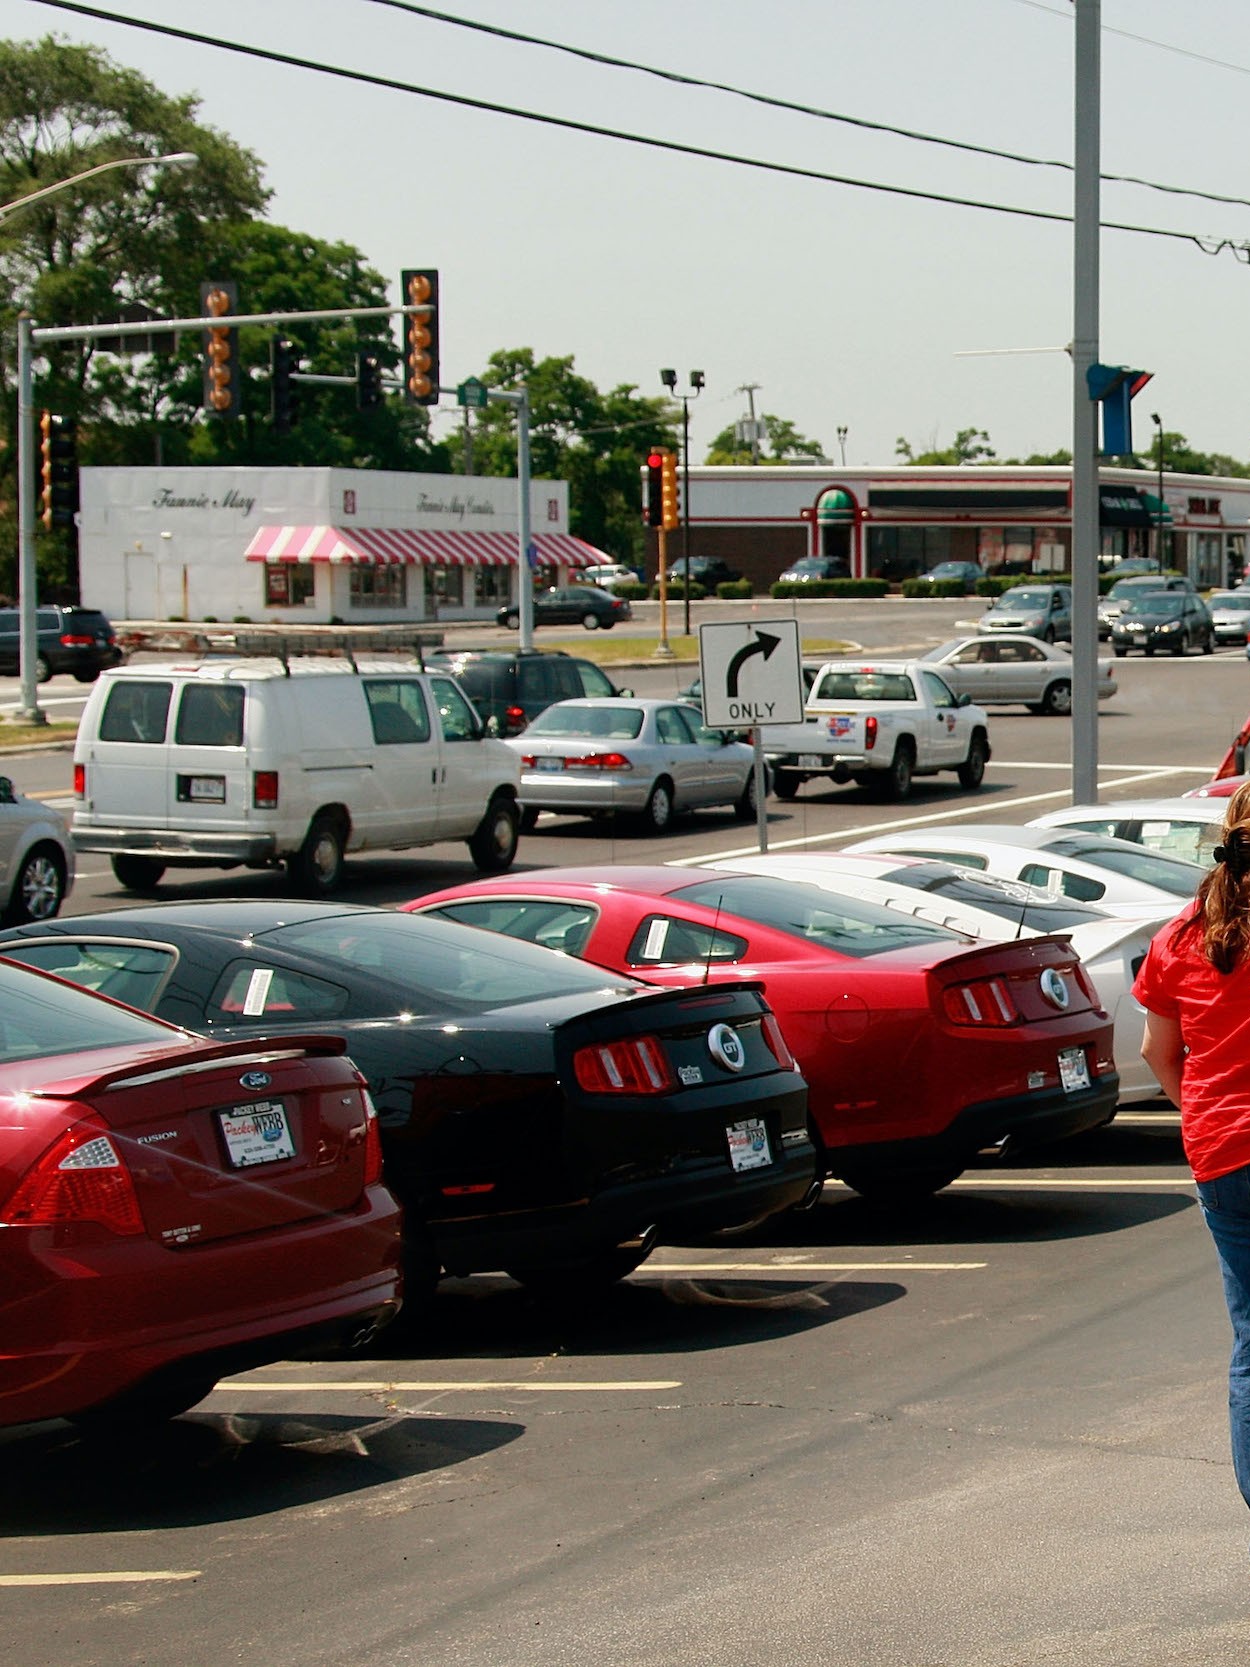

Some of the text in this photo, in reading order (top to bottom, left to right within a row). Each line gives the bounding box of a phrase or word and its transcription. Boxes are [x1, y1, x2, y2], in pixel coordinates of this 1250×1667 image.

[152, 488, 256, 517] Fannie May
[729, 702, 776, 719] ONLY
[723, 1041, 738, 1054] GT
[224, 1112, 284, 1137] Packey WEBB
[137, 1130, 178, 1145] FUSION
